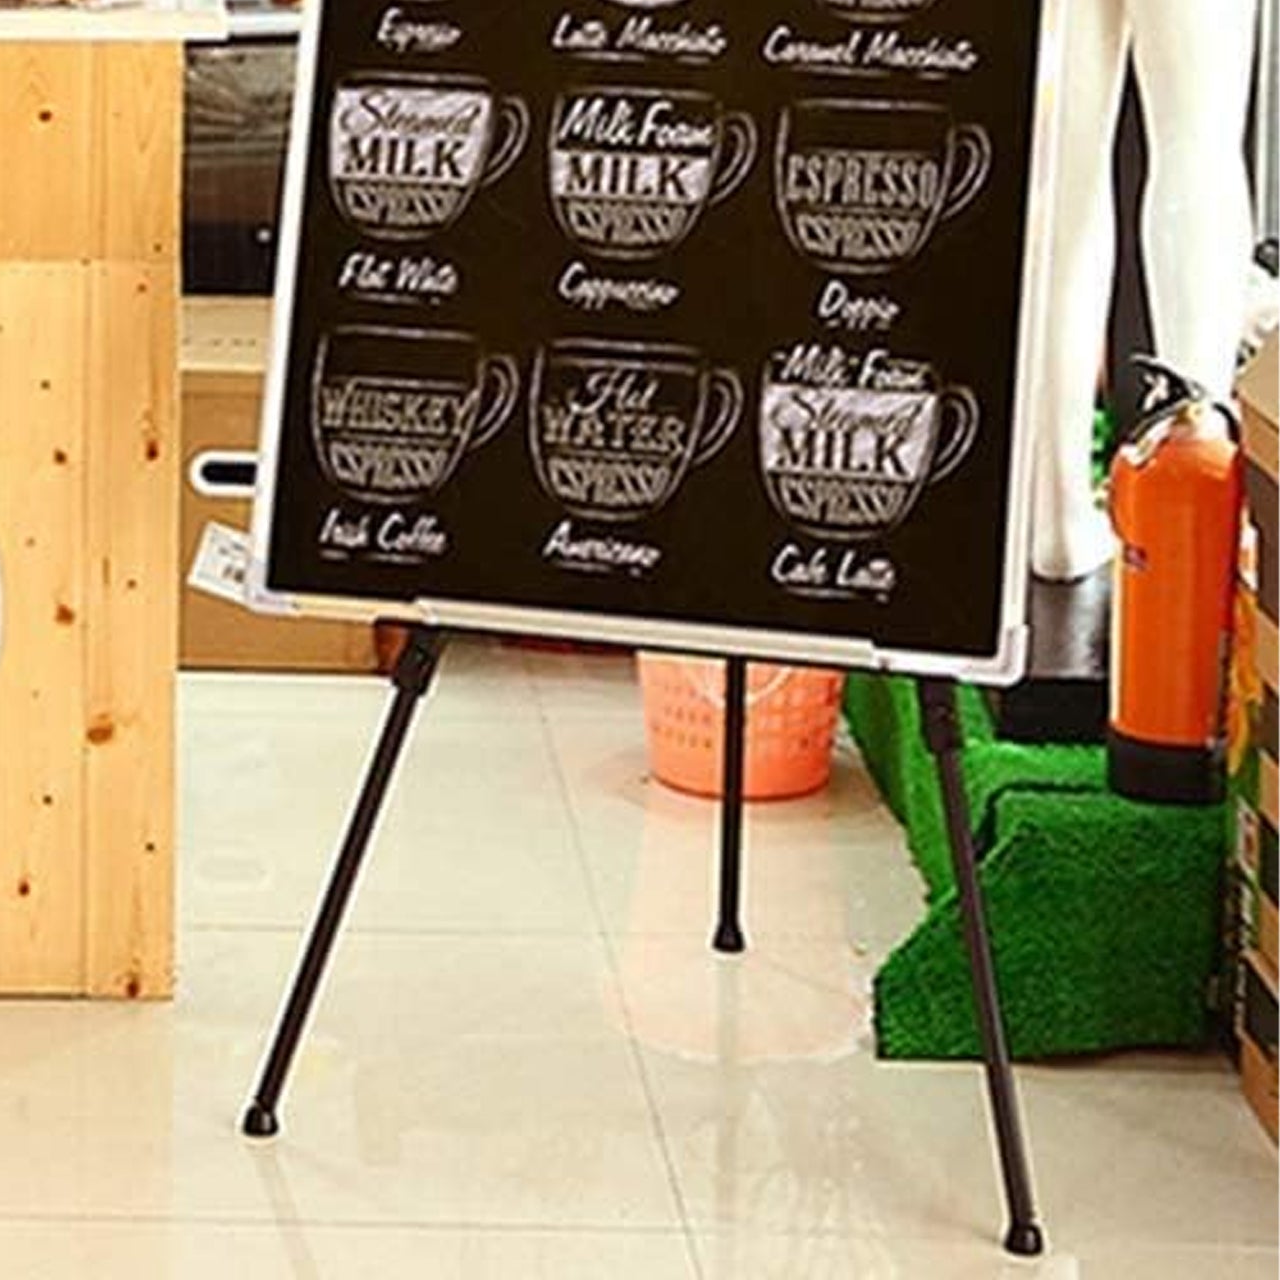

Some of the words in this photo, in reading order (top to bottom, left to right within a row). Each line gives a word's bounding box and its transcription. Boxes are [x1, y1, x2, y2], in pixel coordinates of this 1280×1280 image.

[345, 137, 463, 178] MILK
[566, 156, 688, 197] MILK
[787, 155, 938, 209] ESPRESSO
[321, 378, 480, 435] WHISKEY
[542, 406, 686, 460] WATER
[775, 427, 909, 477] MILK
